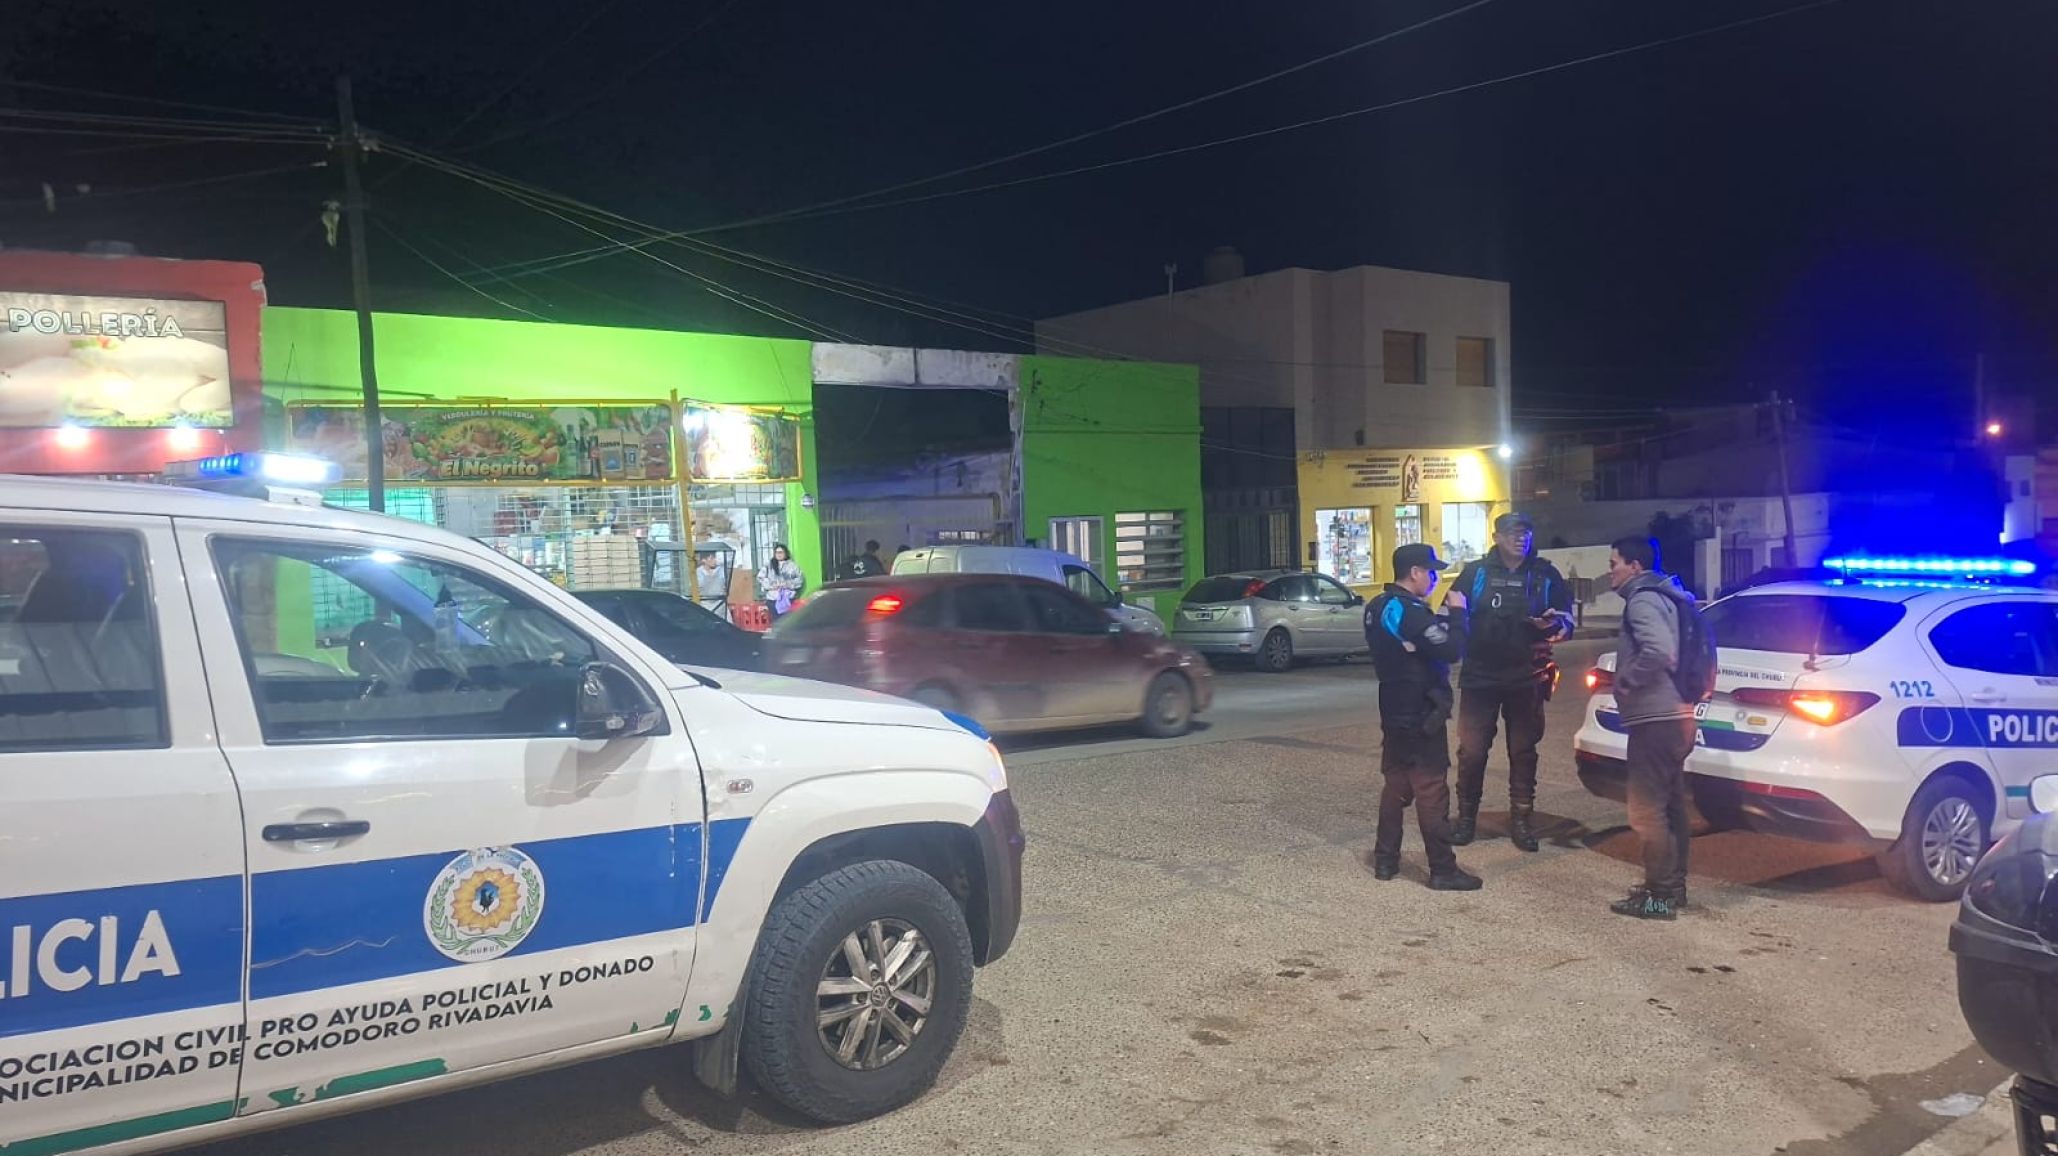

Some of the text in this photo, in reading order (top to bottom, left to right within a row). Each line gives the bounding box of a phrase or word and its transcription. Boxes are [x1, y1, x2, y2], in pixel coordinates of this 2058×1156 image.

[8, 307, 184, 337] POLLERÍA
[440, 460, 539, 478] El Negrito
[1890, 681, 1934, 697] 1212
[0, 910, 181, 999] ICIA
[174, 1024, 251, 1050] CIVIL
[261, 1013, 318, 1038] PRO
[327, 998, 413, 1027] AYUDA
[422, 978, 531, 1011] POLICIAL
[540, 973, 553, 990] Y
[559, 956, 654, 986] DONADO
[208, 1048, 241, 1069] DE
[254, 1018, 420, 1060] COMODORO
[428, 995, 553, 1030] RIVADAVIA
